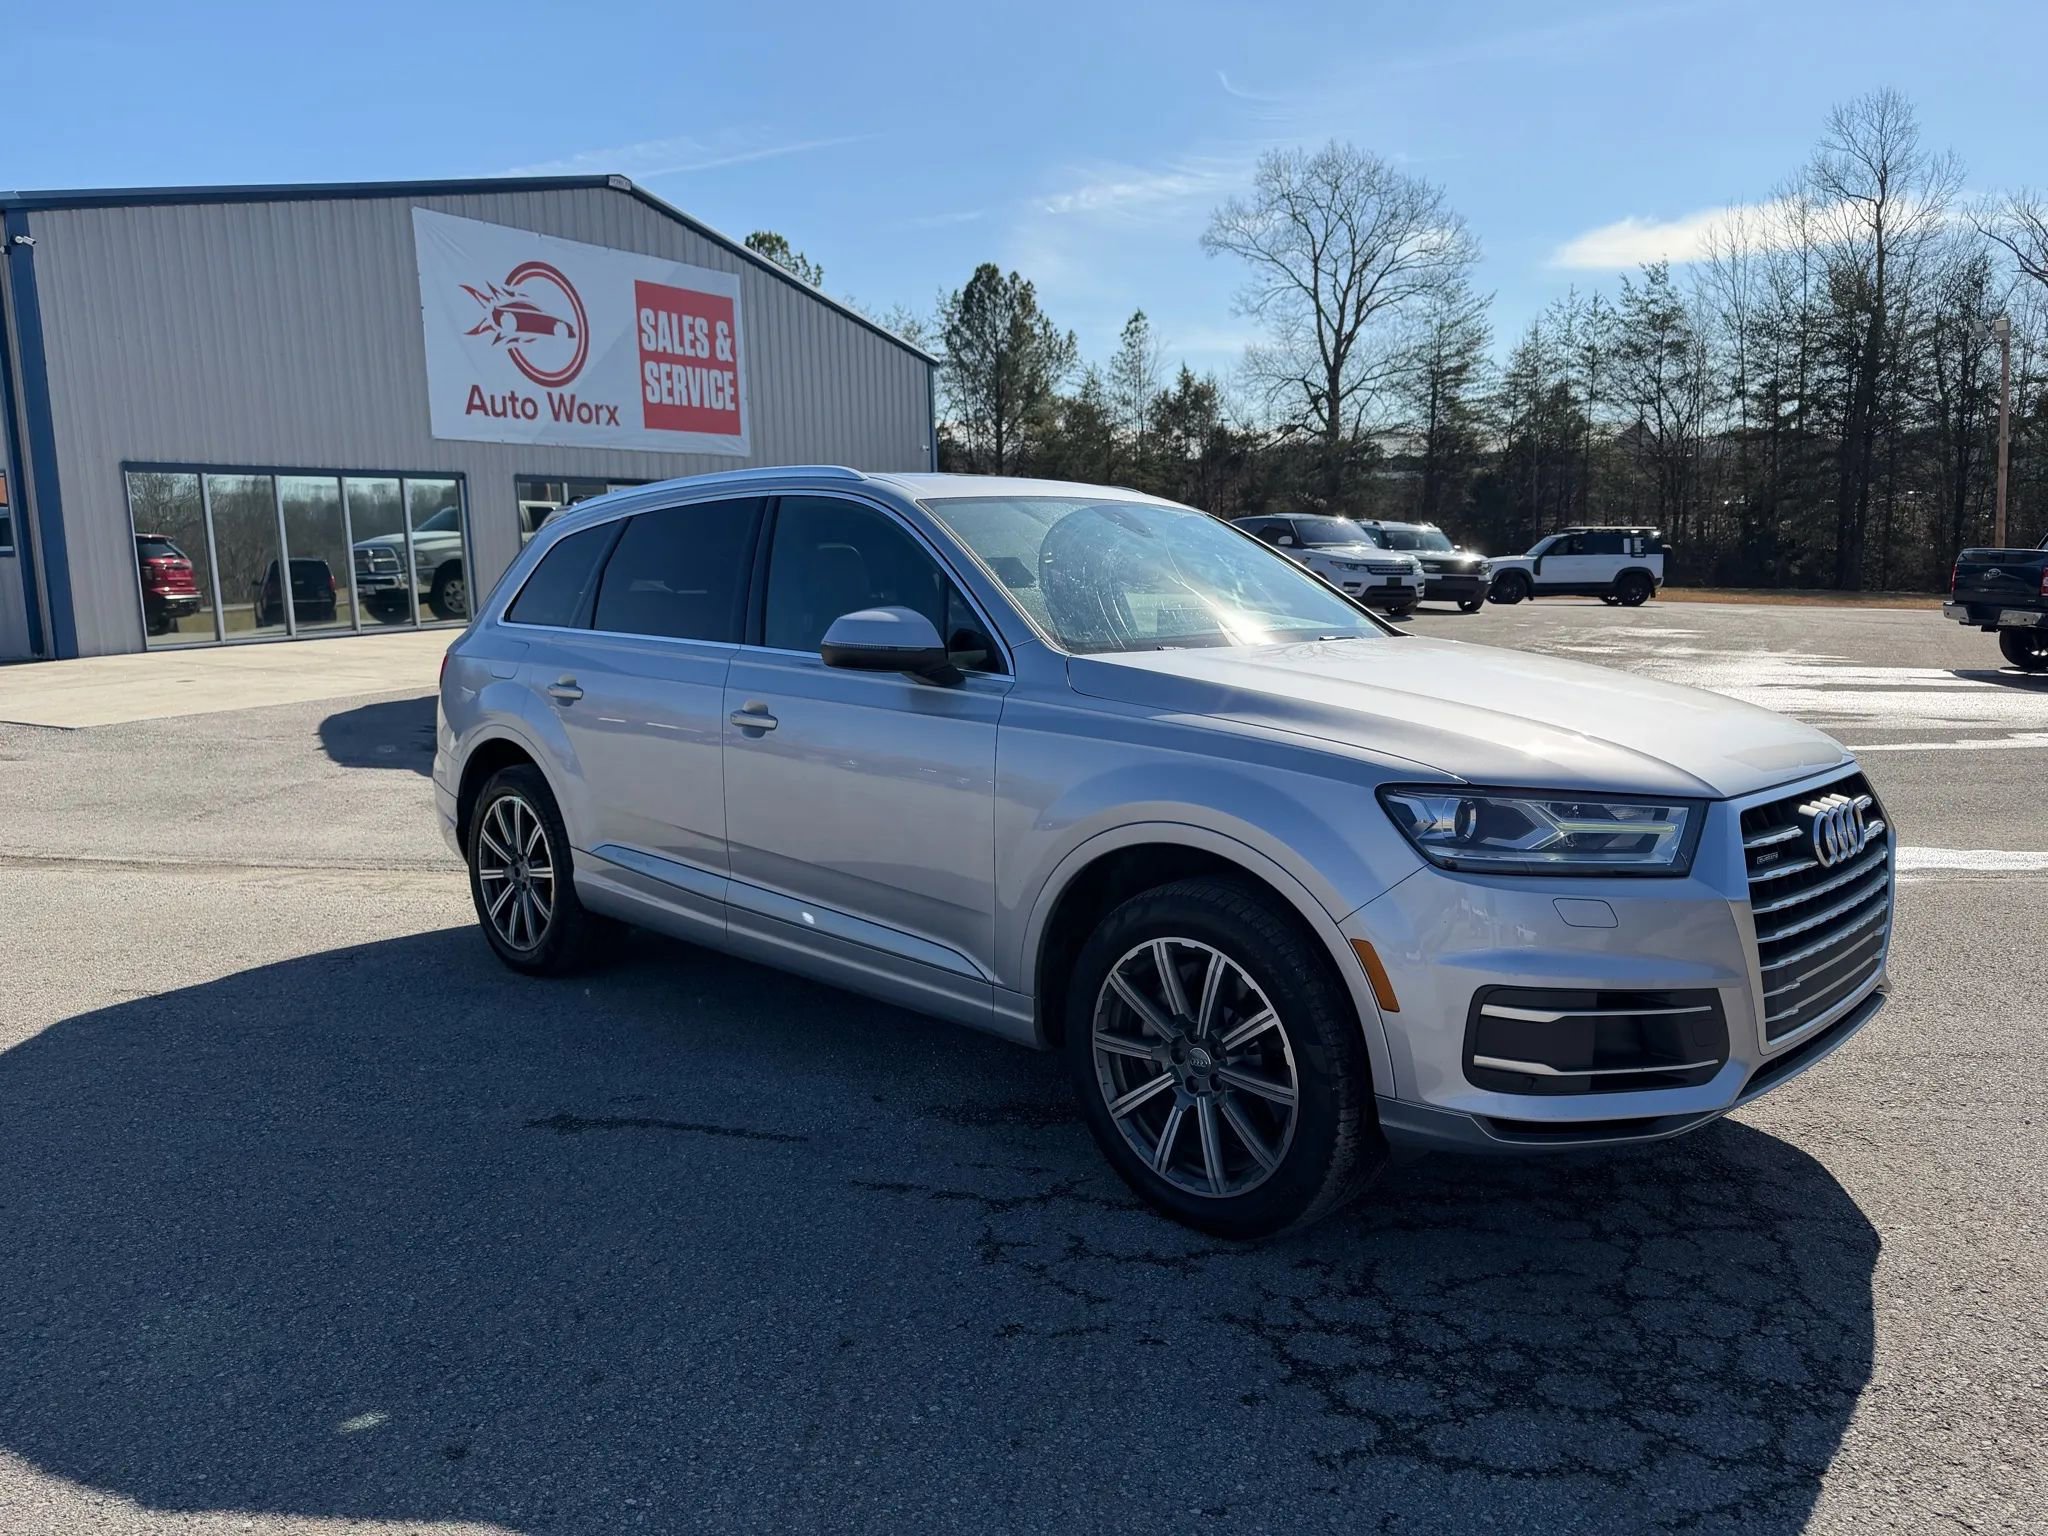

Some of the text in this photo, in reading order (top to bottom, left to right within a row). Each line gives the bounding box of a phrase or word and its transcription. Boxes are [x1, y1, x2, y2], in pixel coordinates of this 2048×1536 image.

[640, 308, 734, 362] SALES &
[465, 384, 620, 426] Auto Worx
[644, 361, 736, 411] SERVICE
